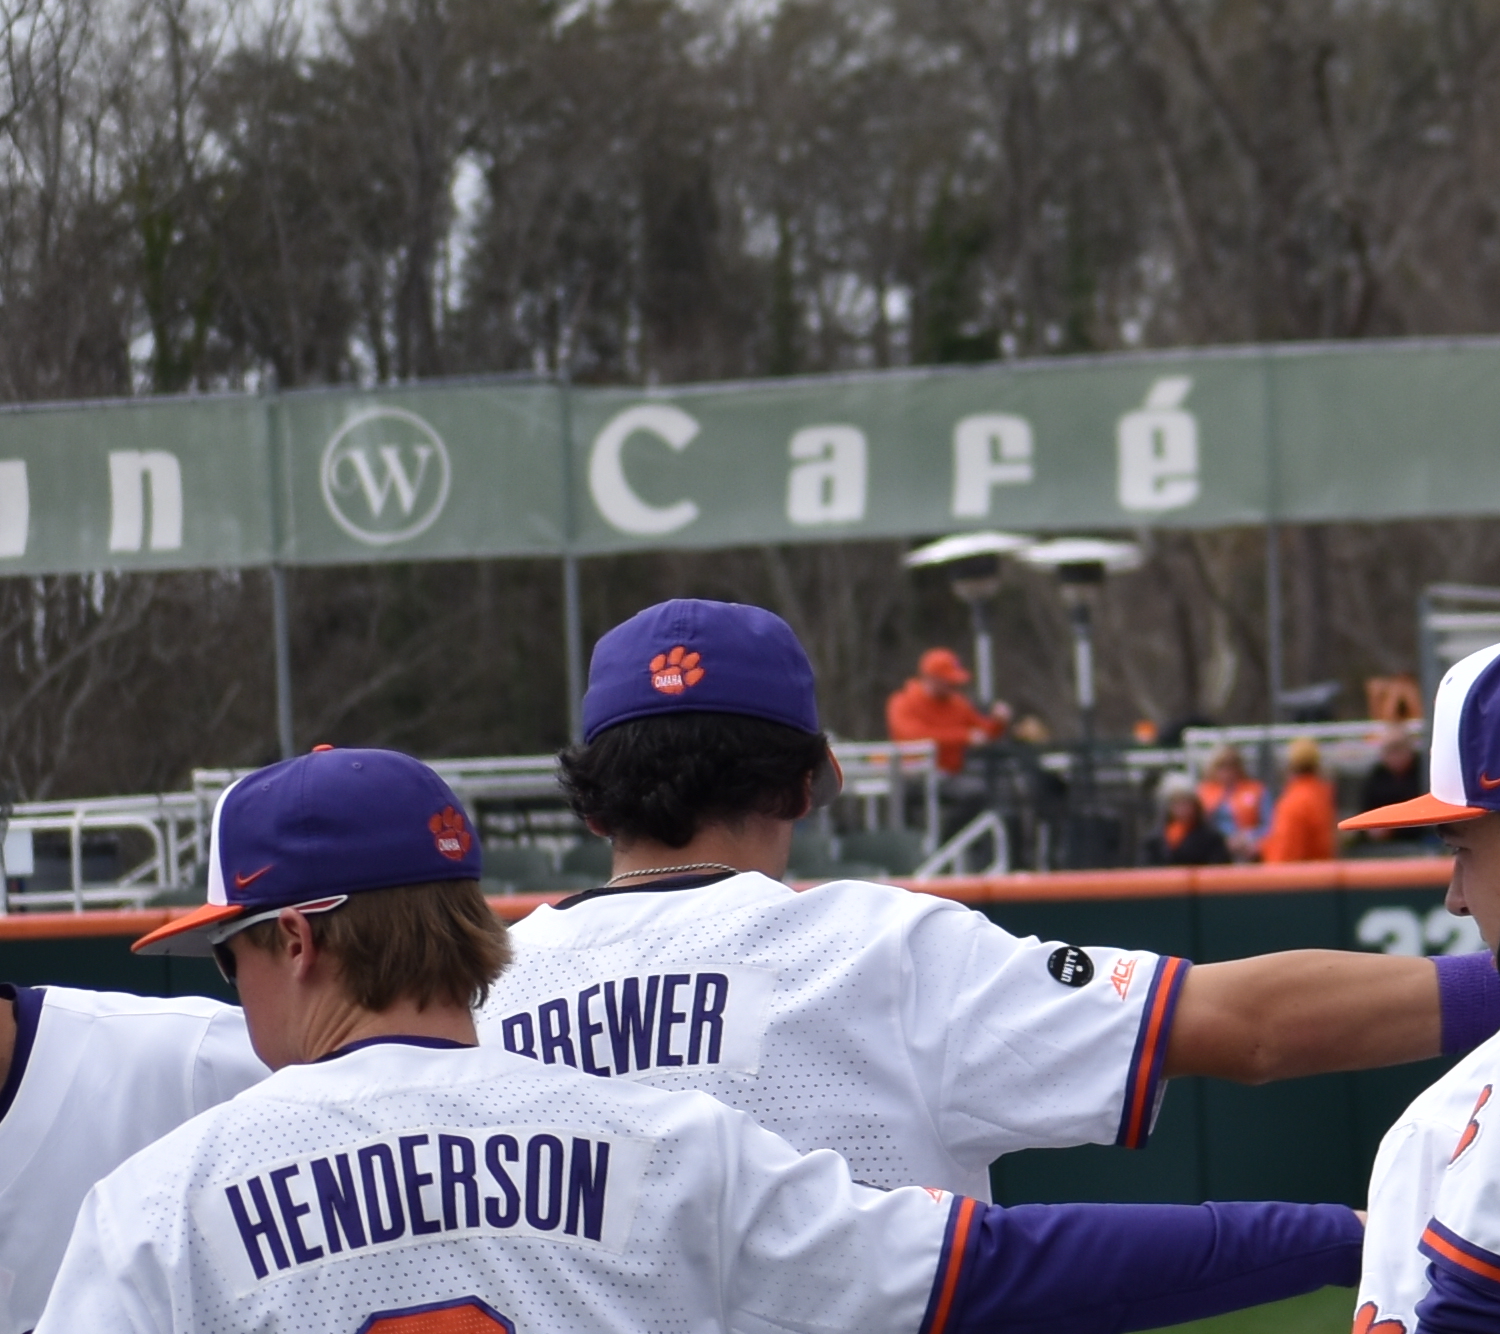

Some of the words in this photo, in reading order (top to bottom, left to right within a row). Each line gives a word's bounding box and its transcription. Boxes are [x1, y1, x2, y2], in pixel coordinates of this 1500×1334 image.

[589, 376, 1200, 535] Café
[654, 673, 683, 688] OMAHA
[1060, 948, 1079, 983] UNITY
[1111, 958, 1139, 1002] ACC
[225, 1133, 611, 1280] HENDERSON
